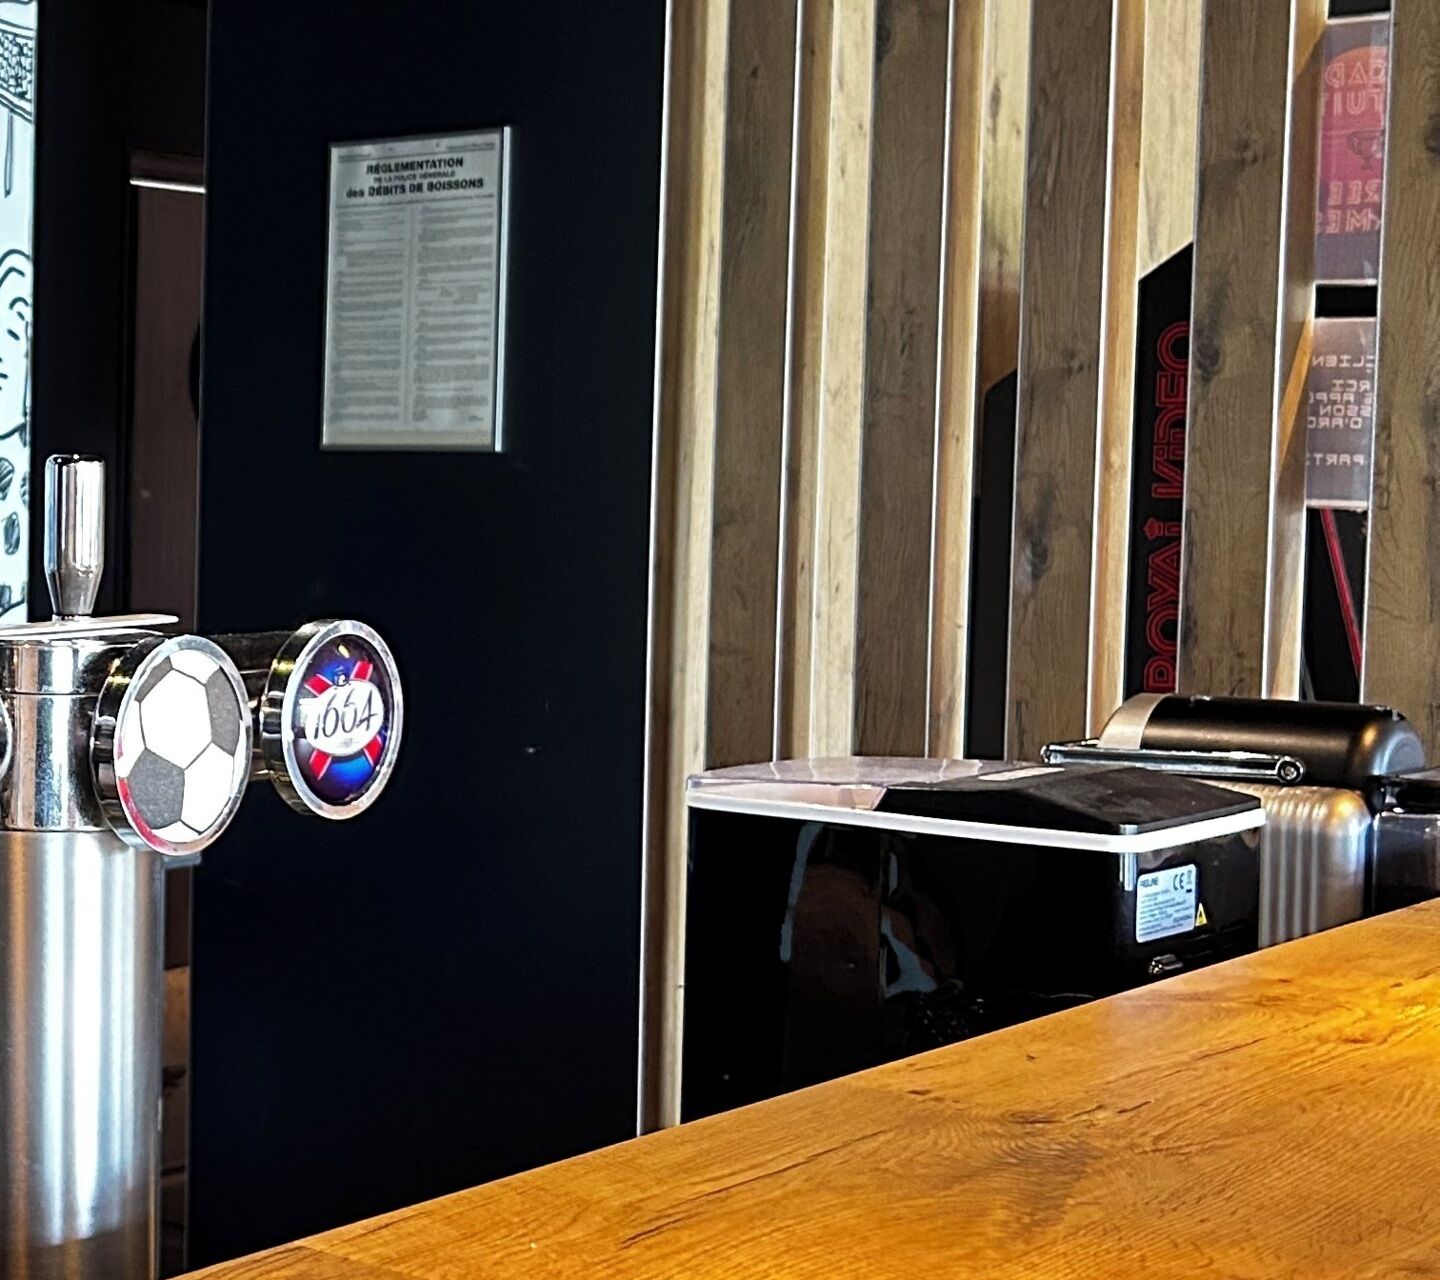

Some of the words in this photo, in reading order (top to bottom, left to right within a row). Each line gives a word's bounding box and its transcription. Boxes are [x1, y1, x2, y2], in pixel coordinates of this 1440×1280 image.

[346, 188, 365, 198] des
[409, 183, 423, 194] DE
[427, 178, 484, 192] BOISSONS
[313, 687, 379, 740] 1664
